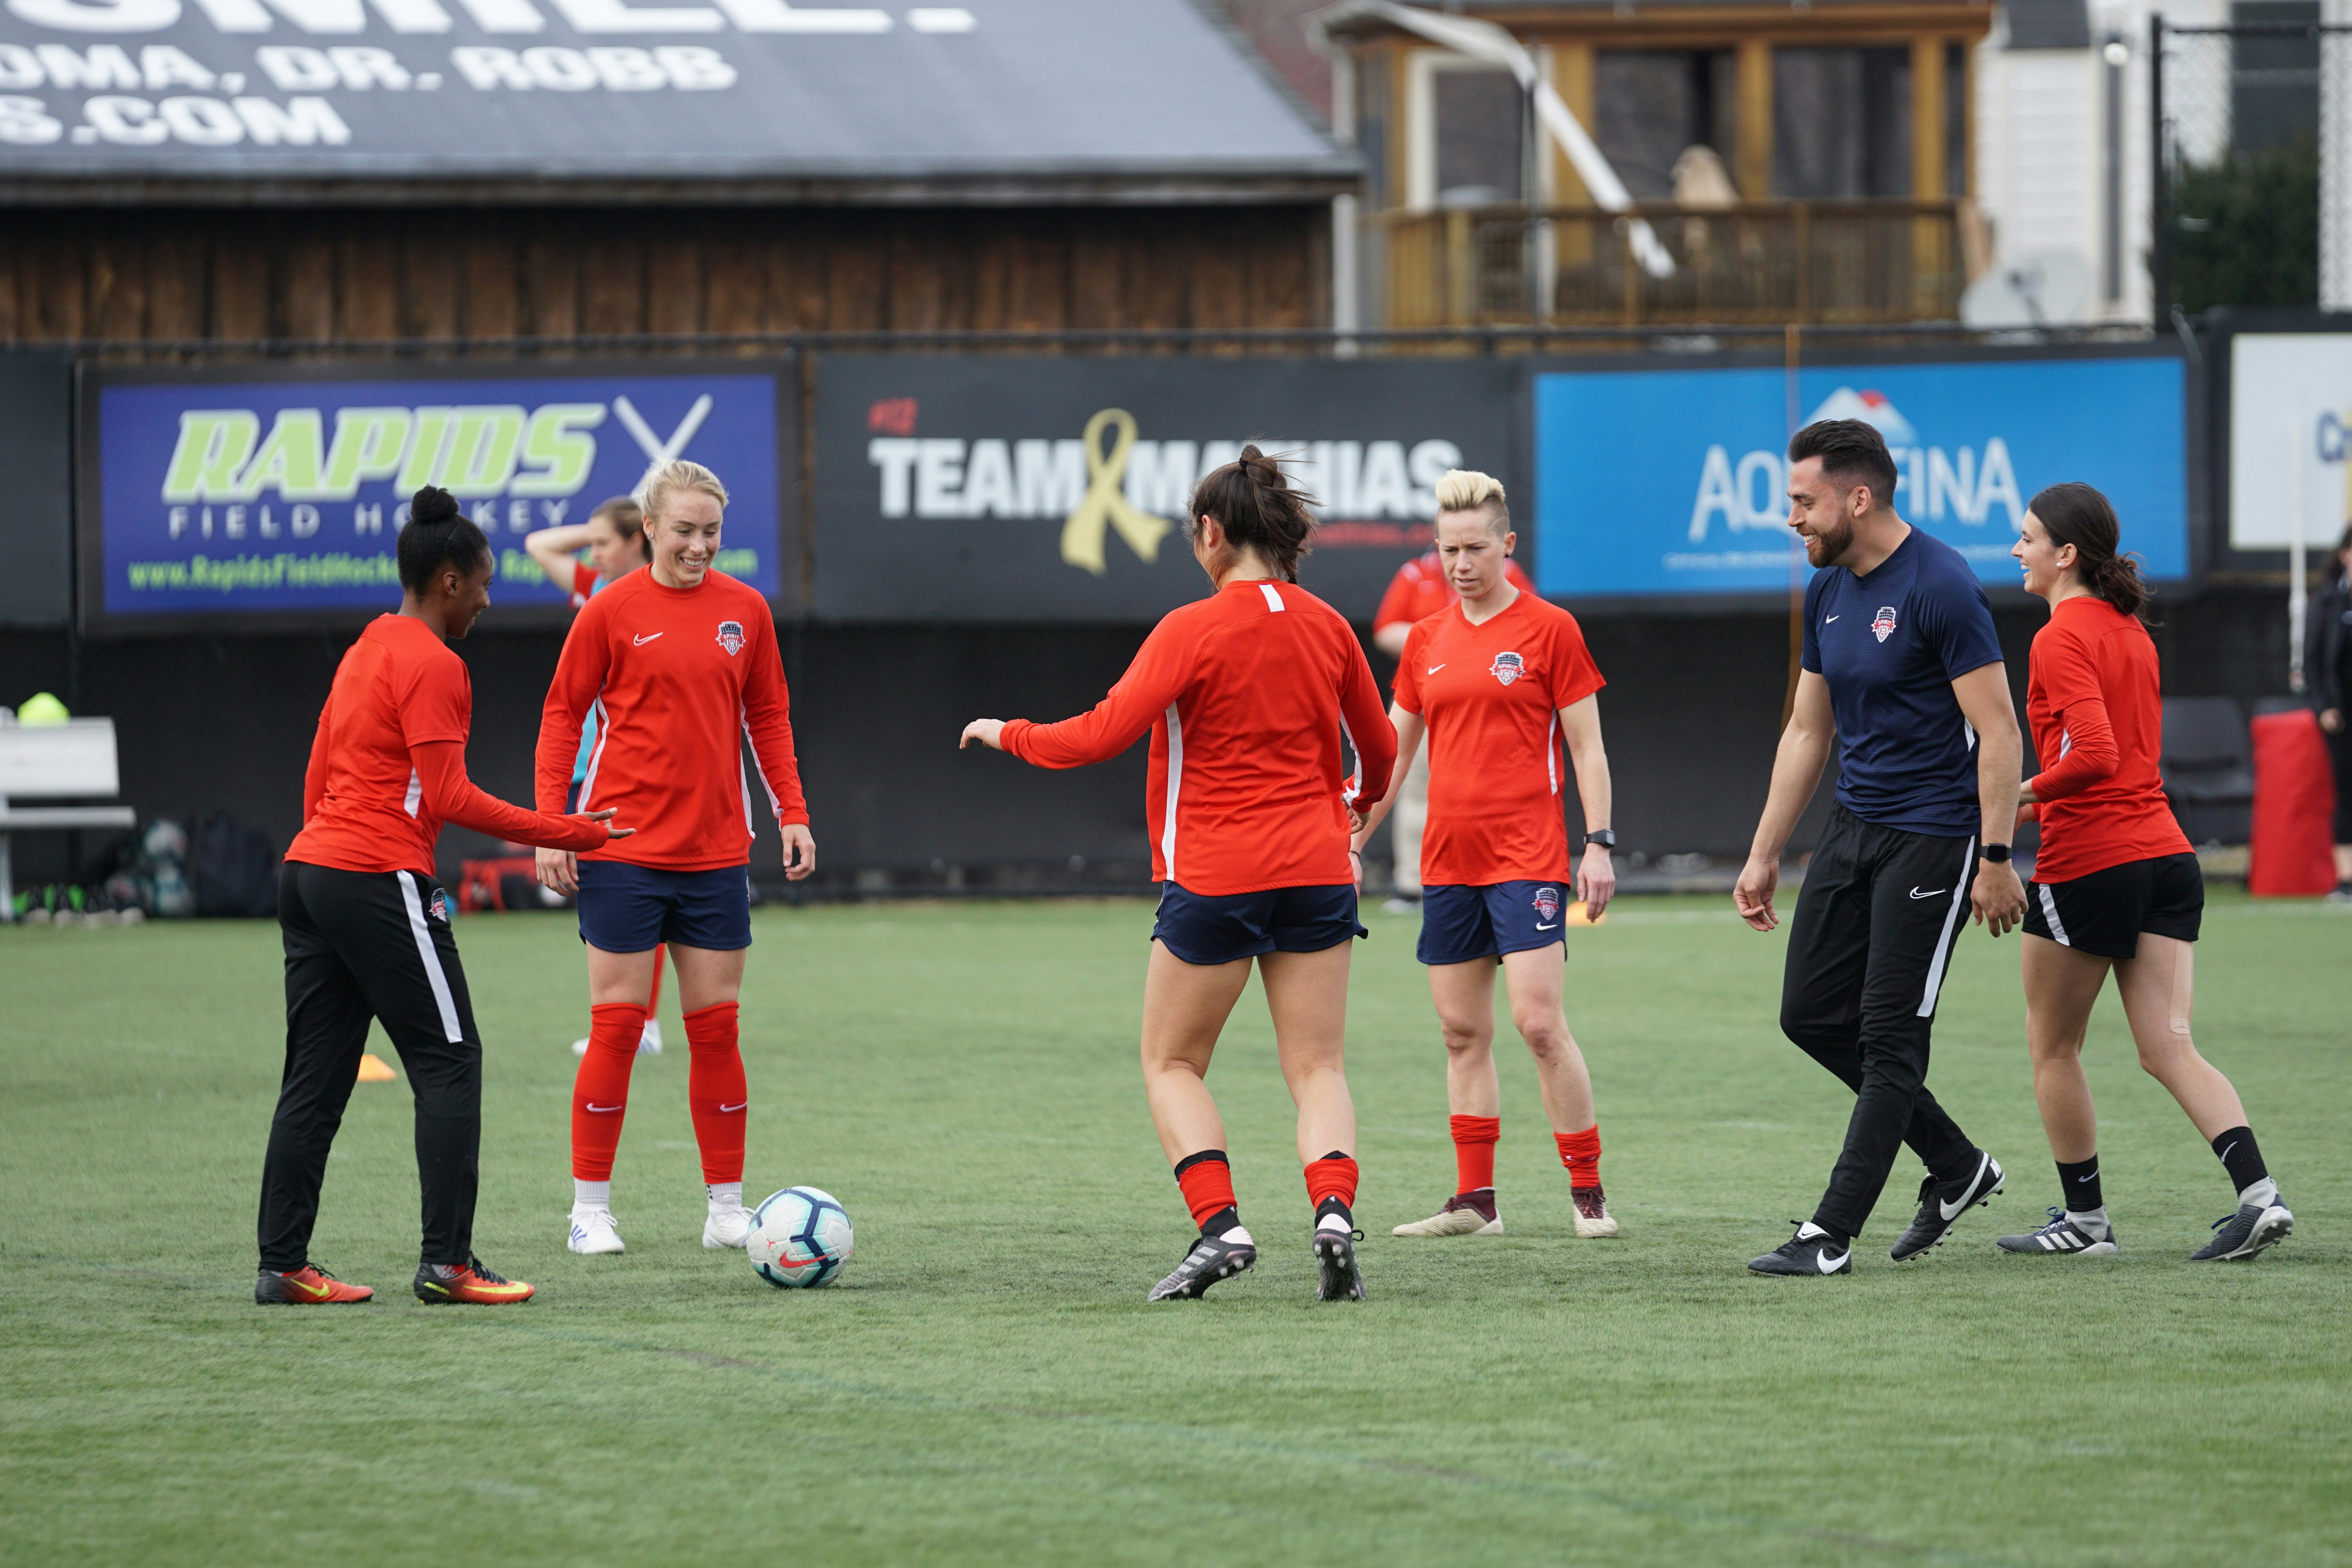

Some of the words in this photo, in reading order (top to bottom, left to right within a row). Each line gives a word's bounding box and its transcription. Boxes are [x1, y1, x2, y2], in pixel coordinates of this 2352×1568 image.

[255, 45, 443, 91] DR.
[450, 46, 738, 91] ROBB
[162, 403, 608, 504] RAPIDS
[868, 438, 1088, 519] TEAM
[169, 503, 321, 539] FIELD
